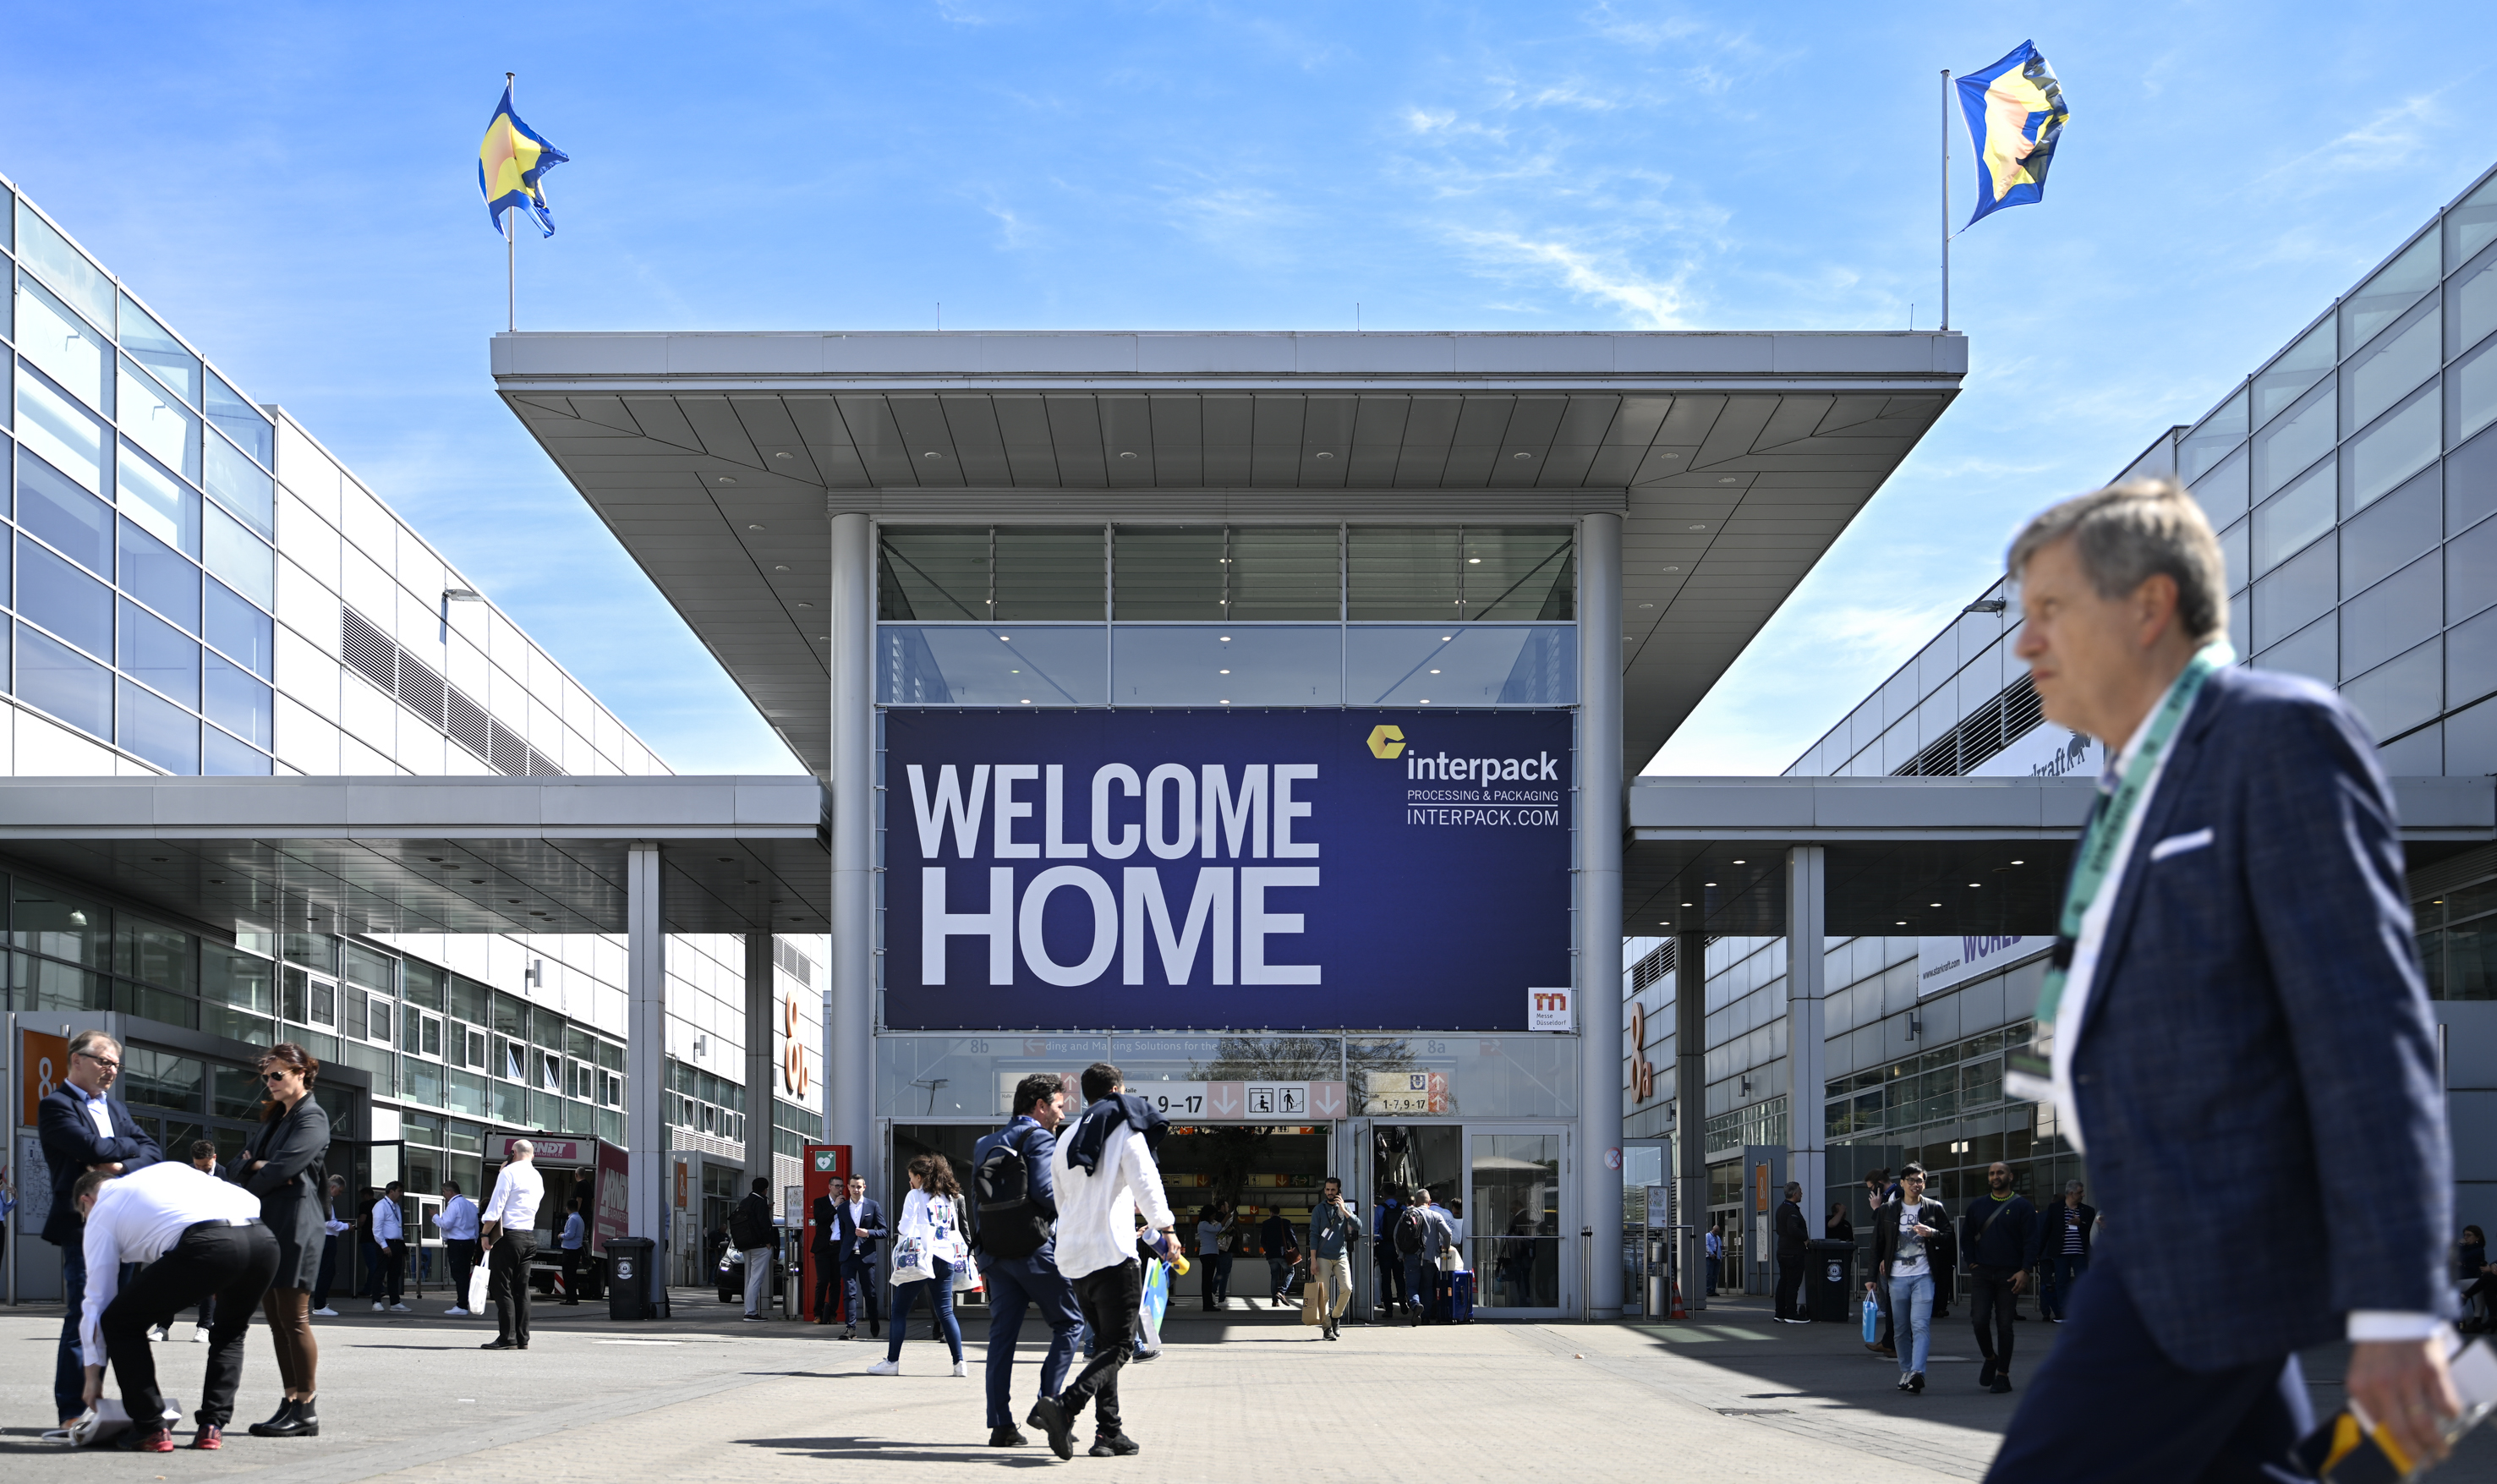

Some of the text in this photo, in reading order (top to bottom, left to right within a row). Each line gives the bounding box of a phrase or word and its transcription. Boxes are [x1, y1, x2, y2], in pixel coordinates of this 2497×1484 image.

[1408, 750, 1558, 787] interpack
[2029, 747, 2065, 776] kraft
[1408, 790, 1558, 801] PROCESSING & PACKAGING
[906, 763, 1320, 859] WELCOME
[1408, 809, 1558, 826] INTERPACK.COM
[923, 866, 1322, 987] HOME
[1922, 959, 1961, 980] www.starkraft.com
[785, 990, 808, 1096] 8b
[971, 1039, 989, 1054] 8b
[1045, 1041, 1315, 1052] ding and Making Solutions for the Packaging Industry
[1427, 1040, 1446, 1054] 8a
[1630, 1002, 1652, 1103] 8a
[38, 1057, 57, 1100] 8
[534, 1142, 567, 1154] RNDT
